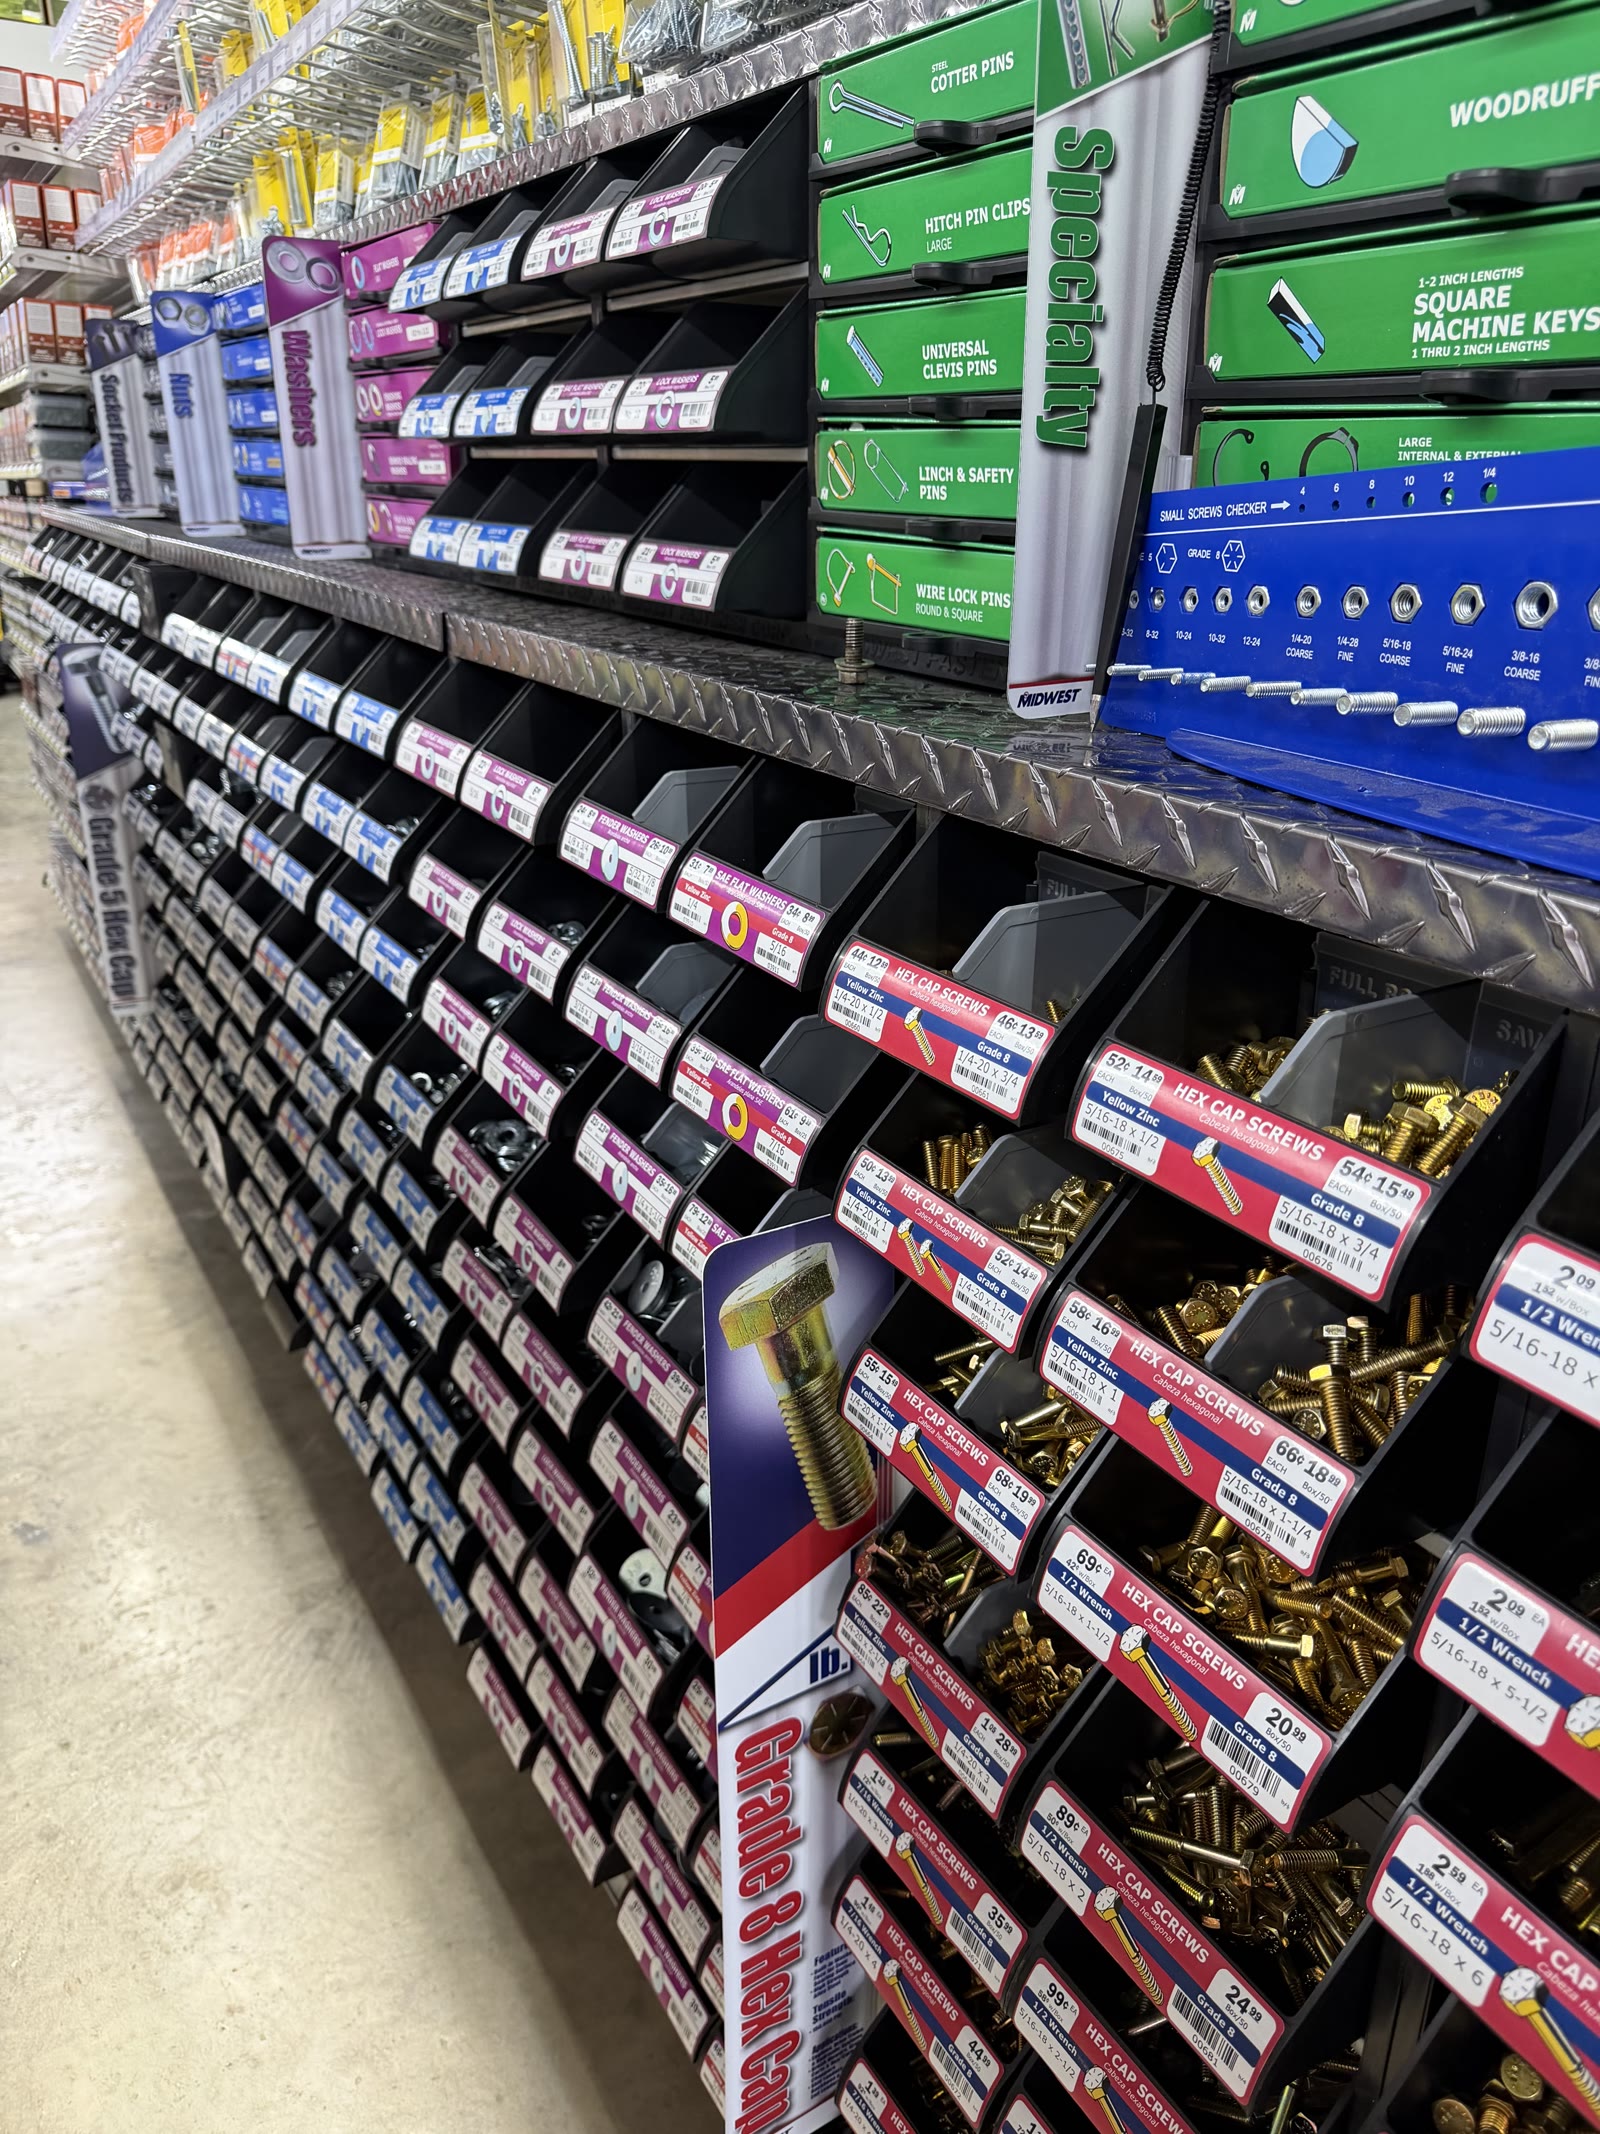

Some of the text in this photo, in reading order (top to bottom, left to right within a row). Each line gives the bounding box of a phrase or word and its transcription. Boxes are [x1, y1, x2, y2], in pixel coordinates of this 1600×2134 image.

[930, 51, 1014, 94] COTTER PINS
[931, 60, 948, 74] STEEL
[1450, 72, 1600, 128] WOODRUFF
[925, 197, 1031, 235] HITCH PIN CLIPS
[926, 237, 952, 253] LARGE
[1036, 125, 1114, 448] Specialty
[1418, 266, 1524, 288] 1-2 INCH LENGTHS
[1413, 285, 1512, 319] SQUARE
[1412, 306, 1600, 343] MACHINE KEYS
[922, 340, 989, 361] UNIVERSAL
[1412, 340, 1550, 359] 1 THRU 2 INCH LENGTHS
[923, 358, 997, 380] CLEVIS PINS
[168, 373, 193, 419] Nuts
[282, 330, 317, 448] Washers
[1398, 437, 1433, 448] LARGE
[1398, 451, 1451, 461] INTERNAL
[1453, 451, 1462, 461] &
[919, 466, 1014, 484] LINCH & SAFETY
[919, 485, 947, 501] PINS
[1160, 468, 1496, 522] SMALL SCREWS CHECKER 4 6 8 10 12 1/4
[1187, 549, 1221, 560] GRADE 8
[915, 603, 983, 623] ROUND & SQUARE
[916, 583, 1011, 609] WIRE LOCK PINS
[1145, 629, 1539, 663] 8-32 10-24 10-32 12-24 1/4-20 1/4-28 5/16-18 5/16-24 3/8-16
[1286, 647, 1313, 660] COARSE
[1337, 650, 1354, 662] FINE
[1379, 653, 1411, 666] COARSE
[1446, 662, 1464, 674] FINE
[1503, 667, 1541, 681] COARSE
[1017, 688, 1082, 710] MIDWEST
[599, 814, 649, 844] FENDER WASHERS
[715, 870, 787, 910] SAE FLAT WASHERS
[769, 939, 787, 956] 5/16
[772, 927, 794, 944] Grade 8
[845, 978, 885, 1002] Yellow Zinc
[894, 967, 990, 1017] HEX CAP SCREWS
[977, 1041, 1010, 1063] Grade 8
[1096, 1070, 1154, 1102] EACH Box/50
[1084, 1103, 1159, 1149] 5/16-18 x 1/2
[1102, 1090, 1160, 1127] Yellow Zinc
[1173, 1083, 1325, 1160] HEX CAP SCREWS
[1101, 1142, 1125, 1161] 00675
[1199, 1113, 1279, 1156] Cabeza hexagonal
[1310, 1193, 1364, 1228] Grade 8
[1327, 1179, 1402, 1221] EACH Box/50
[1279, 1201, 1380, 1261] 5/16-18 x 3/4
[1302, 1250, 1333, 1272] 00676
[1066, 1336, 1119, 1381] Yellow Zinc
[1129, 1340, 1265, 1436] HEX CAP SCREWS
[1251, 1467, 1299, 1506] Grade 8
[1244, 1518, 1271, 1542] 00678
[1060, 1570, 1113, 1621] 1/2 Wrench
[1044, 1582, 1110, 1647] 5/16-18 x 1-1/2
[1122, 1581, 1248, 1691] HEX CAP SCREWS
[1143, 1618, 1210, 1675] Cabeza hexagonal
[1458, 1617, 1552, 1689] 1/2 Wrench
[808, 1645, 848, 1685] lb.
[1430, 1631, 1548, 1724] 5/16-18 x 5-1/2
[1234, 1721, 1277, 1762] Grade 8
[1265, 1727, 1292, 1753] Box/50
[1228, 1764, 1260, 1796] 00679
[1097, 1842, 1210, 1964] HEX CAP SCREWS
[735, 1717, 804, 2134] Grade 8 Hex Cap
[1500, 1906, 1598, 1993] HEX CAP
